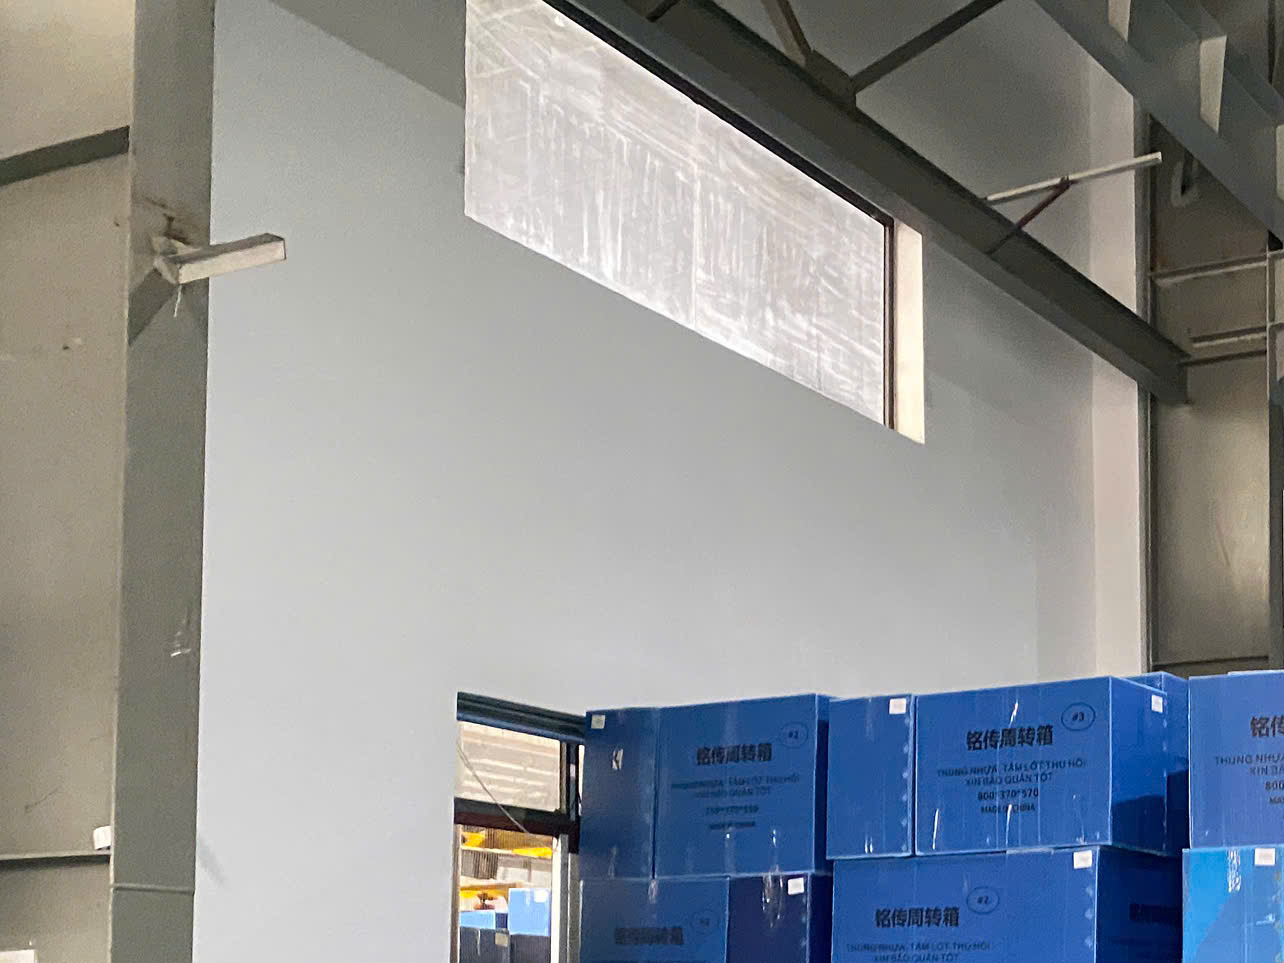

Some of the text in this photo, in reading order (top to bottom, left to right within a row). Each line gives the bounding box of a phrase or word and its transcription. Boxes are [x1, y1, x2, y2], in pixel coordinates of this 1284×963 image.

[966, 724, 1054, 751] 铭传周转箱
[875, 906, 960, 929] 铭传周转箱
